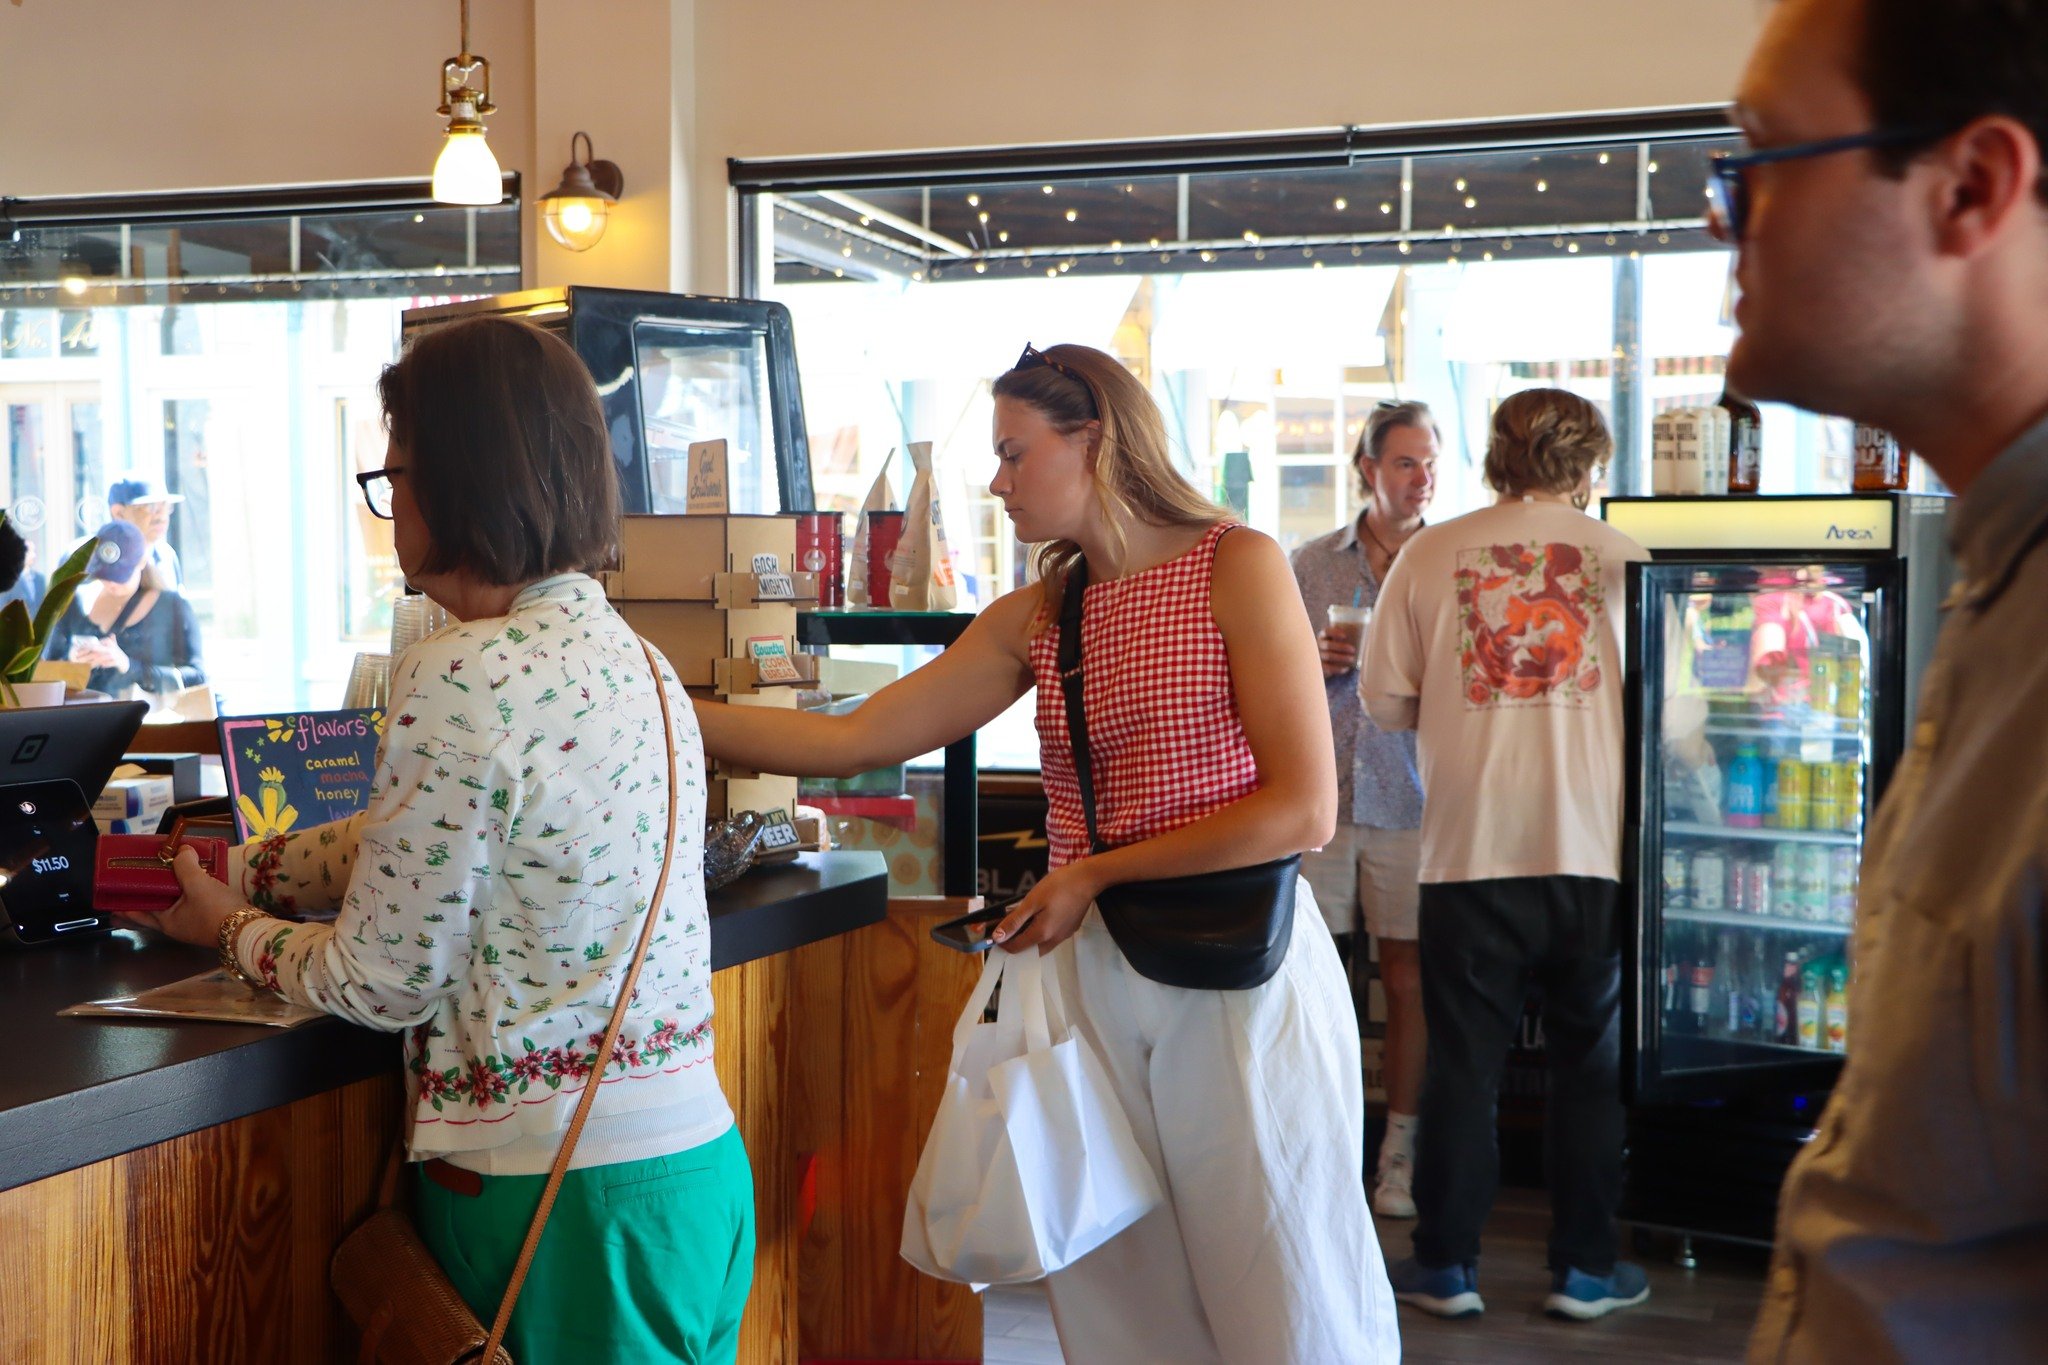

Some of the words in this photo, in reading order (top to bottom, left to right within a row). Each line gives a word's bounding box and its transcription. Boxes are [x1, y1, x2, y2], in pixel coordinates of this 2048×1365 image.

[754, 556, 779, 576] GOSH
[759, 577, 793, 597] MIGHTY
[764, 668, 797, 680] BREAD
[297, 714, 367, 751] flavors
[305, 750, 361, 771] caramel
[315, 787, 359, 806] honey
[32, 855, 70, 874] $11.50
